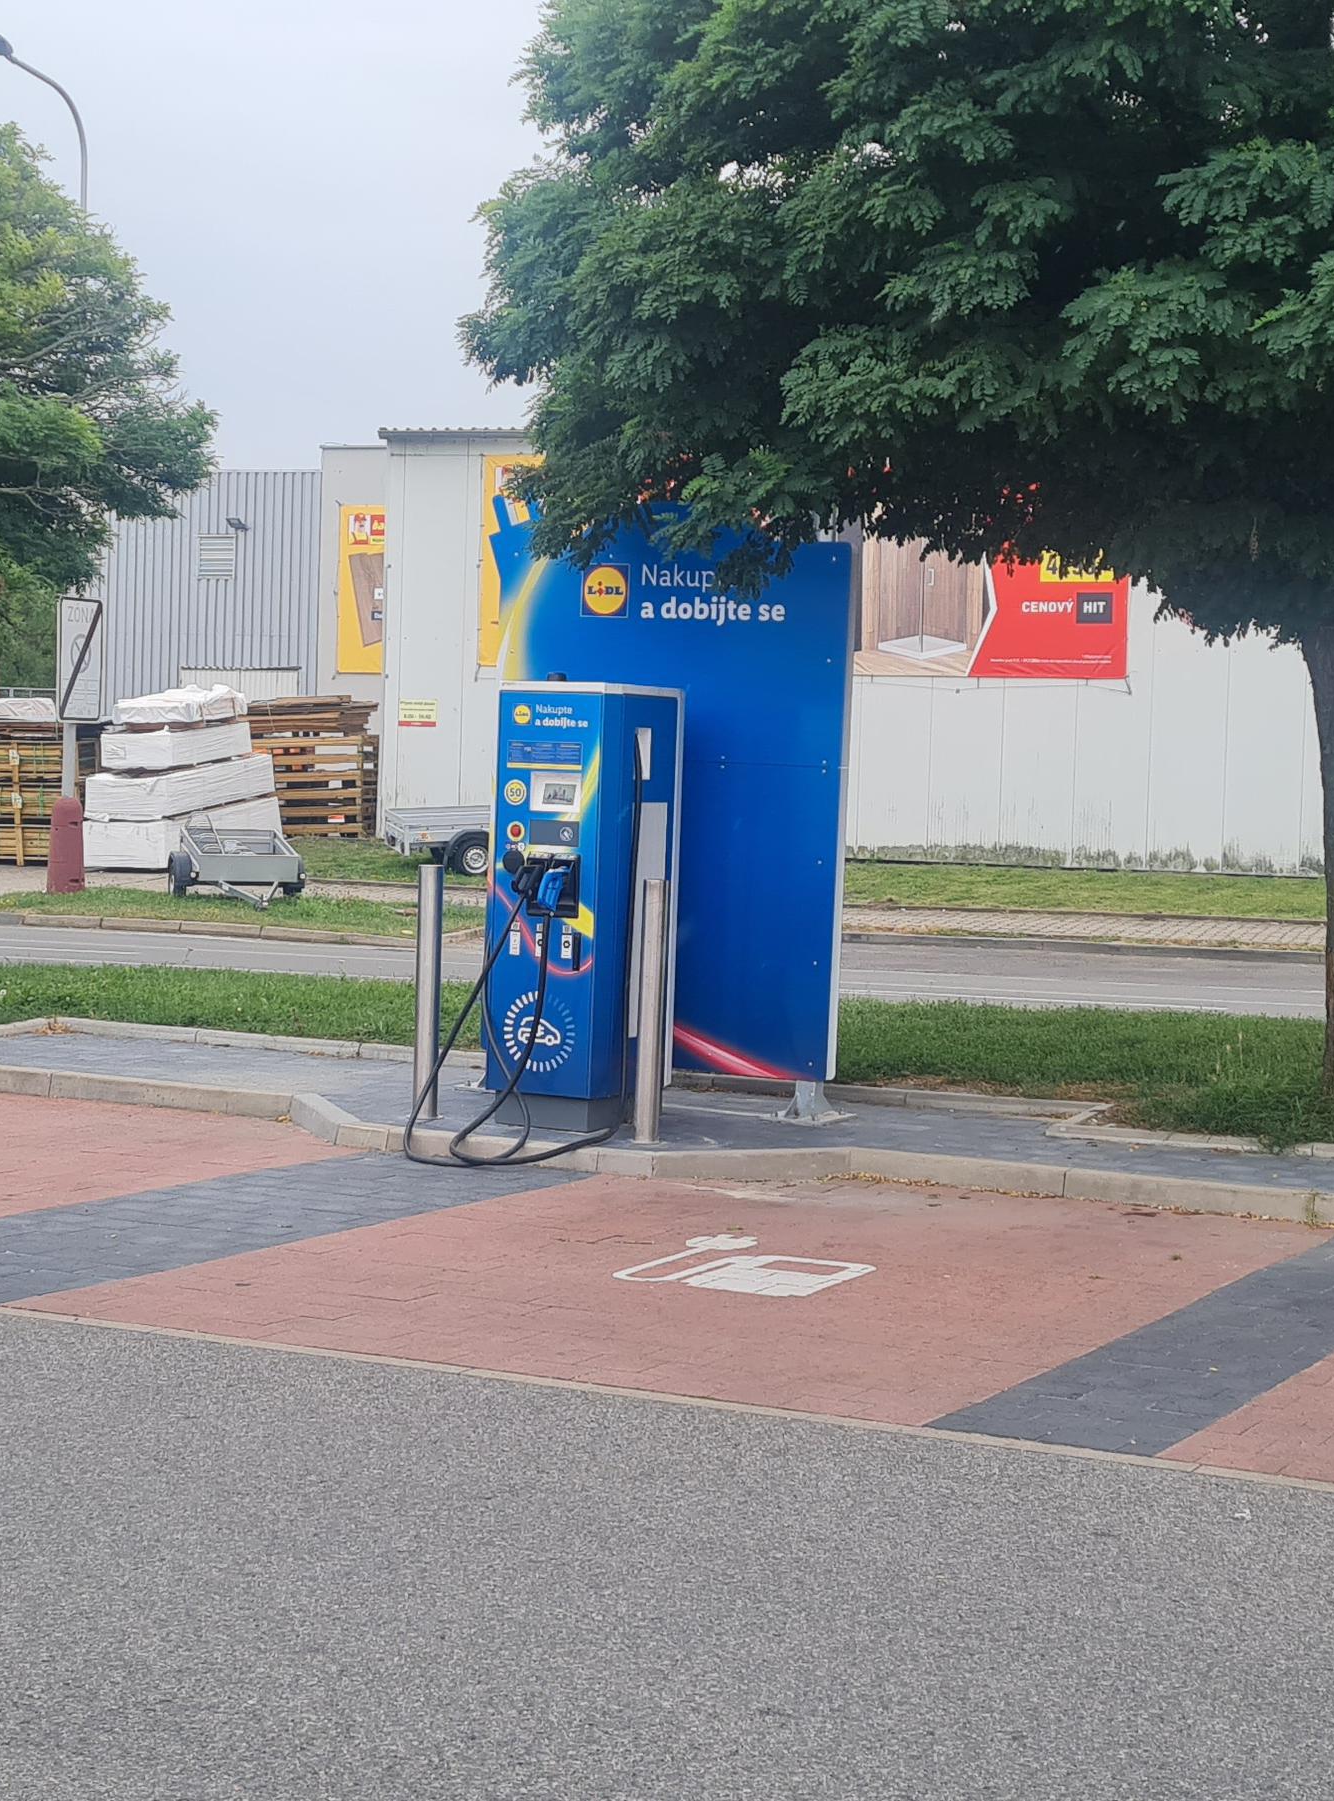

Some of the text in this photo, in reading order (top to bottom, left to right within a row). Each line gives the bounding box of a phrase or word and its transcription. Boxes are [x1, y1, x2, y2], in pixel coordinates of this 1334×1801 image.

[641, 563, 717, 592] Nakup
[640, 596, 787, 626] a dobijte se
[1021, 597, 1107, 614] CENOVÝ HIT
[535, 704, 573, 716] Nakupte
[542, 717, 576, 729] dobijte
[577, 720, 589, 728] se
[509, 787, 522, 798] 50
